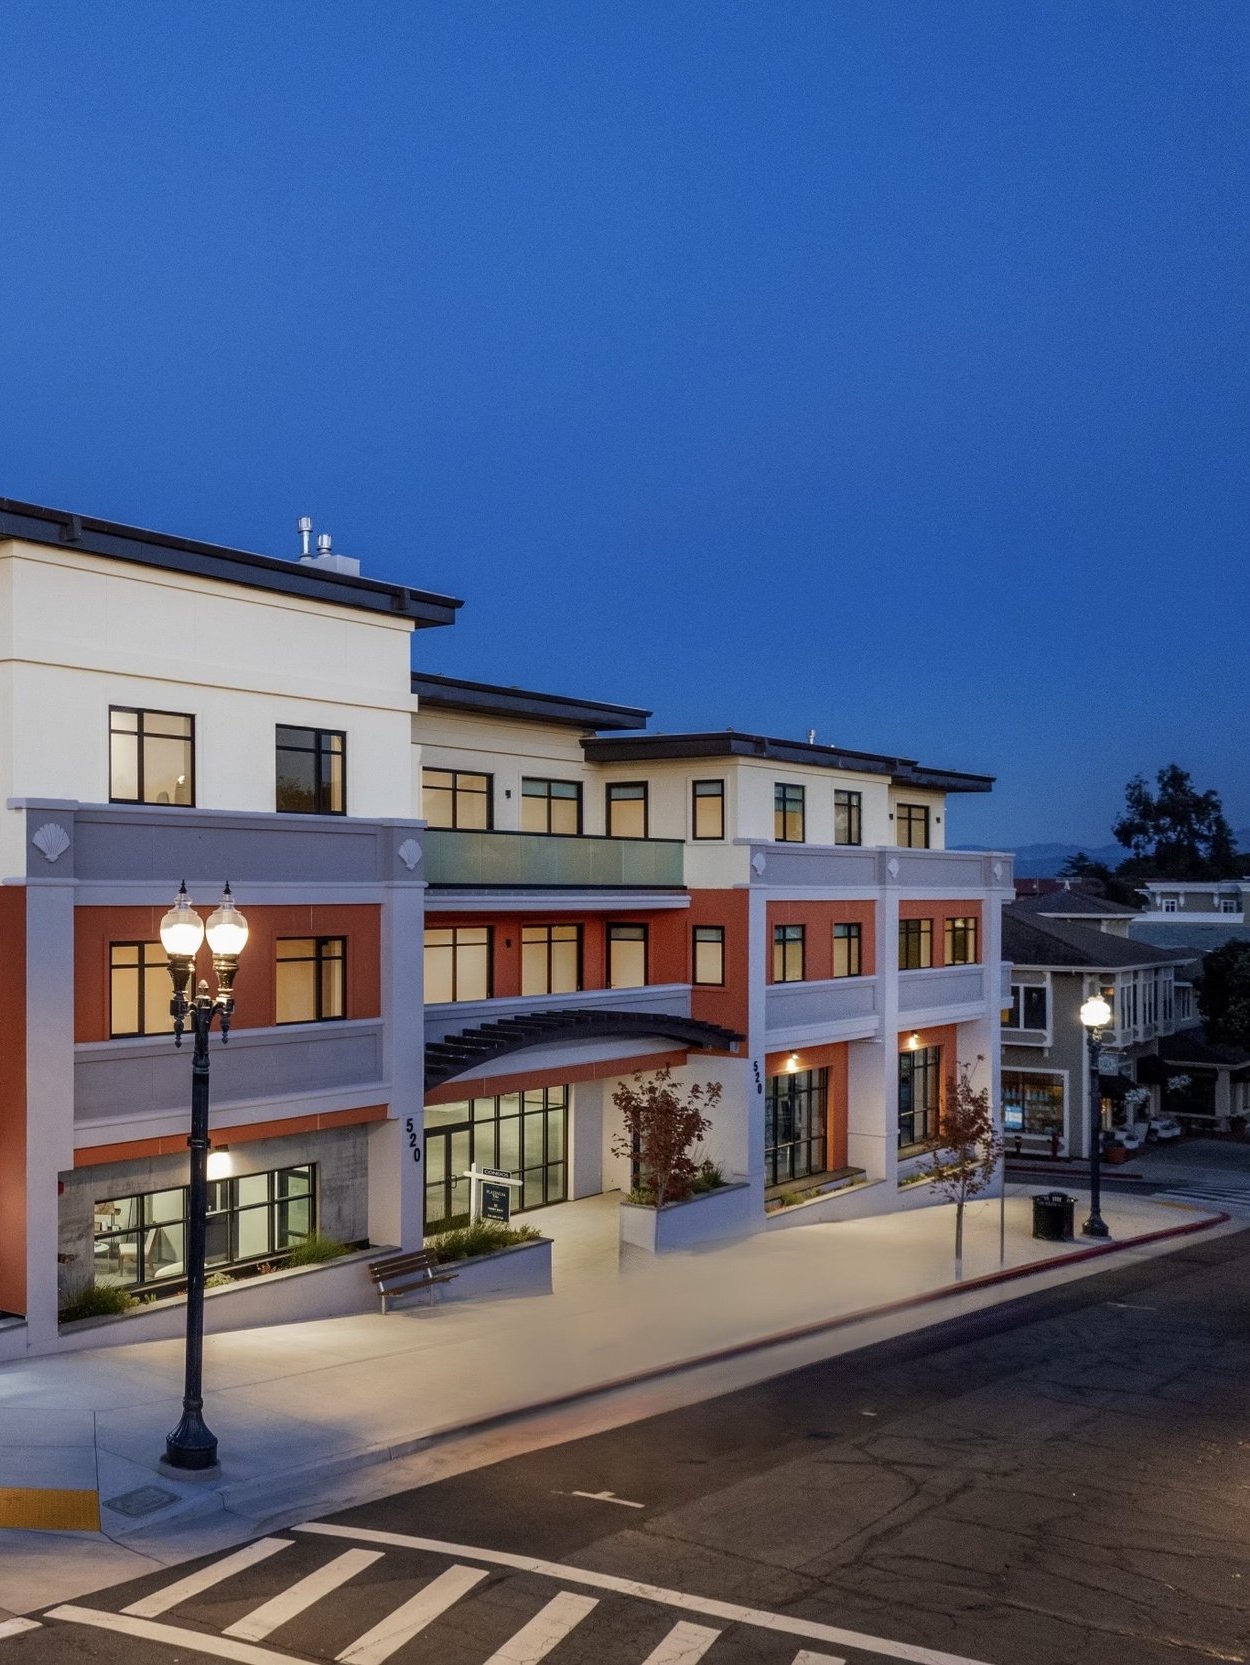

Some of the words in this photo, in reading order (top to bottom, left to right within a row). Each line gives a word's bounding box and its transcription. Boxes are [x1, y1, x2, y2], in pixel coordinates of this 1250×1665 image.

[753, 1060, 762, 1094] 520
[406, 1117, 421, 1162] 520
[484, 1169, 509, 1178] CONDOS
